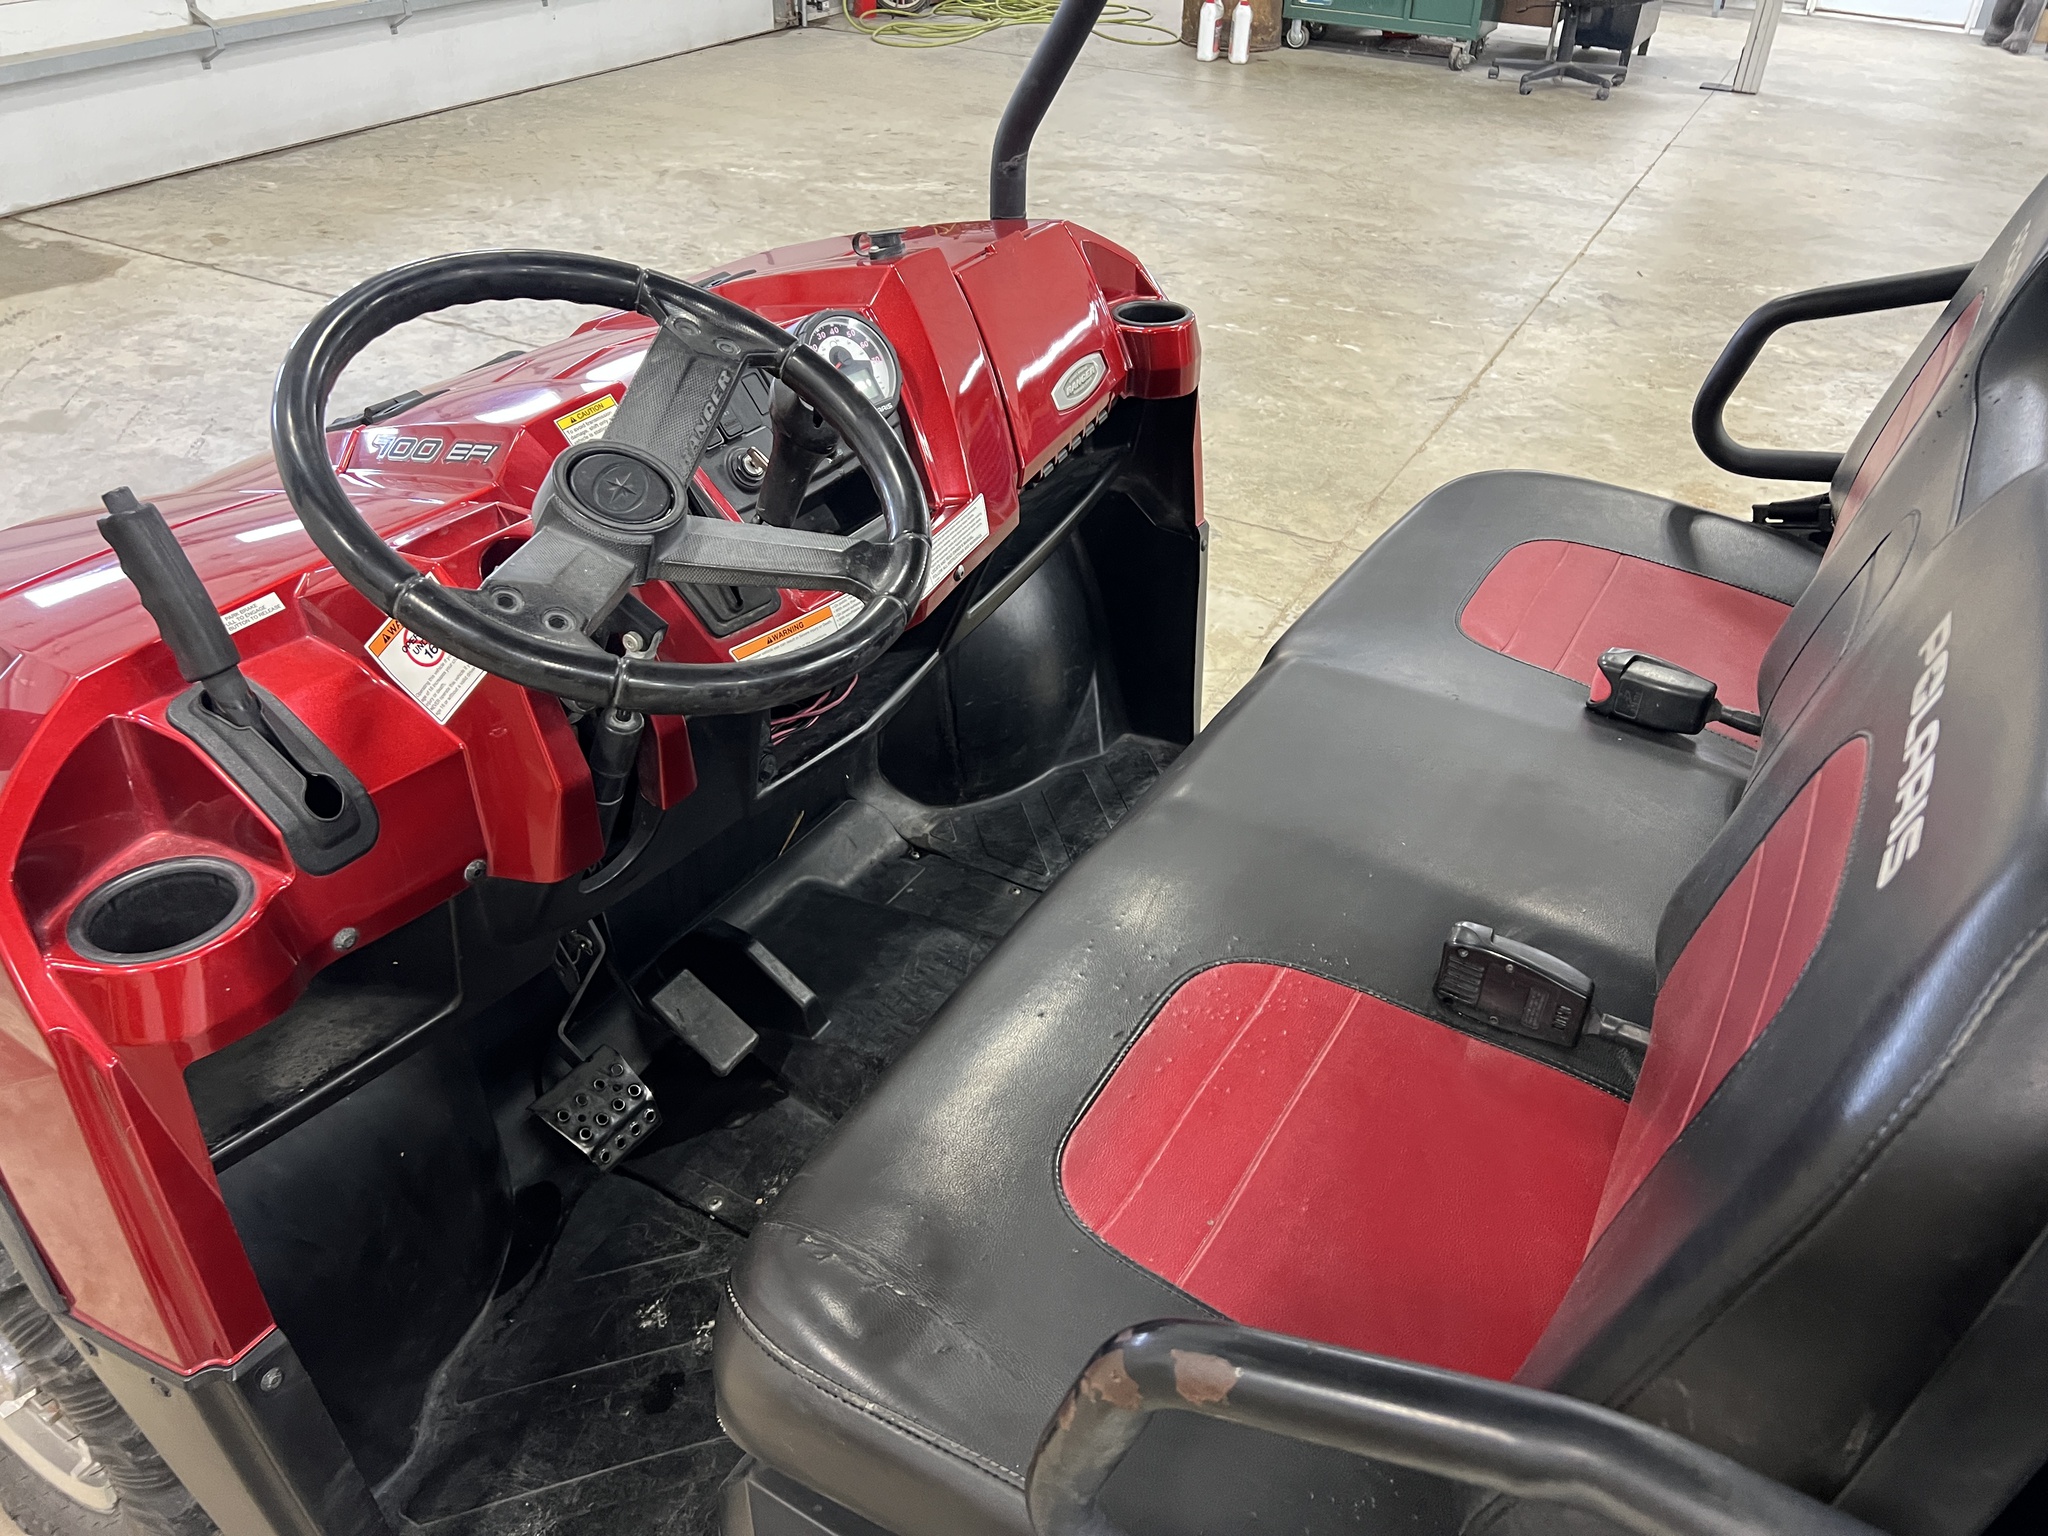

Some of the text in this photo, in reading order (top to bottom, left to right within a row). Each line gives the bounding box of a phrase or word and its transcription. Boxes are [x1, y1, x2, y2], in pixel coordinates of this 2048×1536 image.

[817, 331, 826, 340] 30
[830, 326, 839, 335] 40
[846, 329, 856, 338] 50
[860, 340, 869, 349] 60
[1066, 366, 1096, 395] RANGER
[577, 403, 604, 419] CAUTION
[680, 369, 732, 470] RANGER
[445, 441, 500, 464] EFI
[224, 603, 258, 621] PARK BRAKE
[229, 619, 250, 631] BUTTON
[259, 604, 281, 617] RELEASE
[245, 605, 267, 618] ENGAGE
[771, 621, 804, 641] WARNING
[424, 644, 439, 659] 16
[1876, 610, 1952, 889] POLARIS
